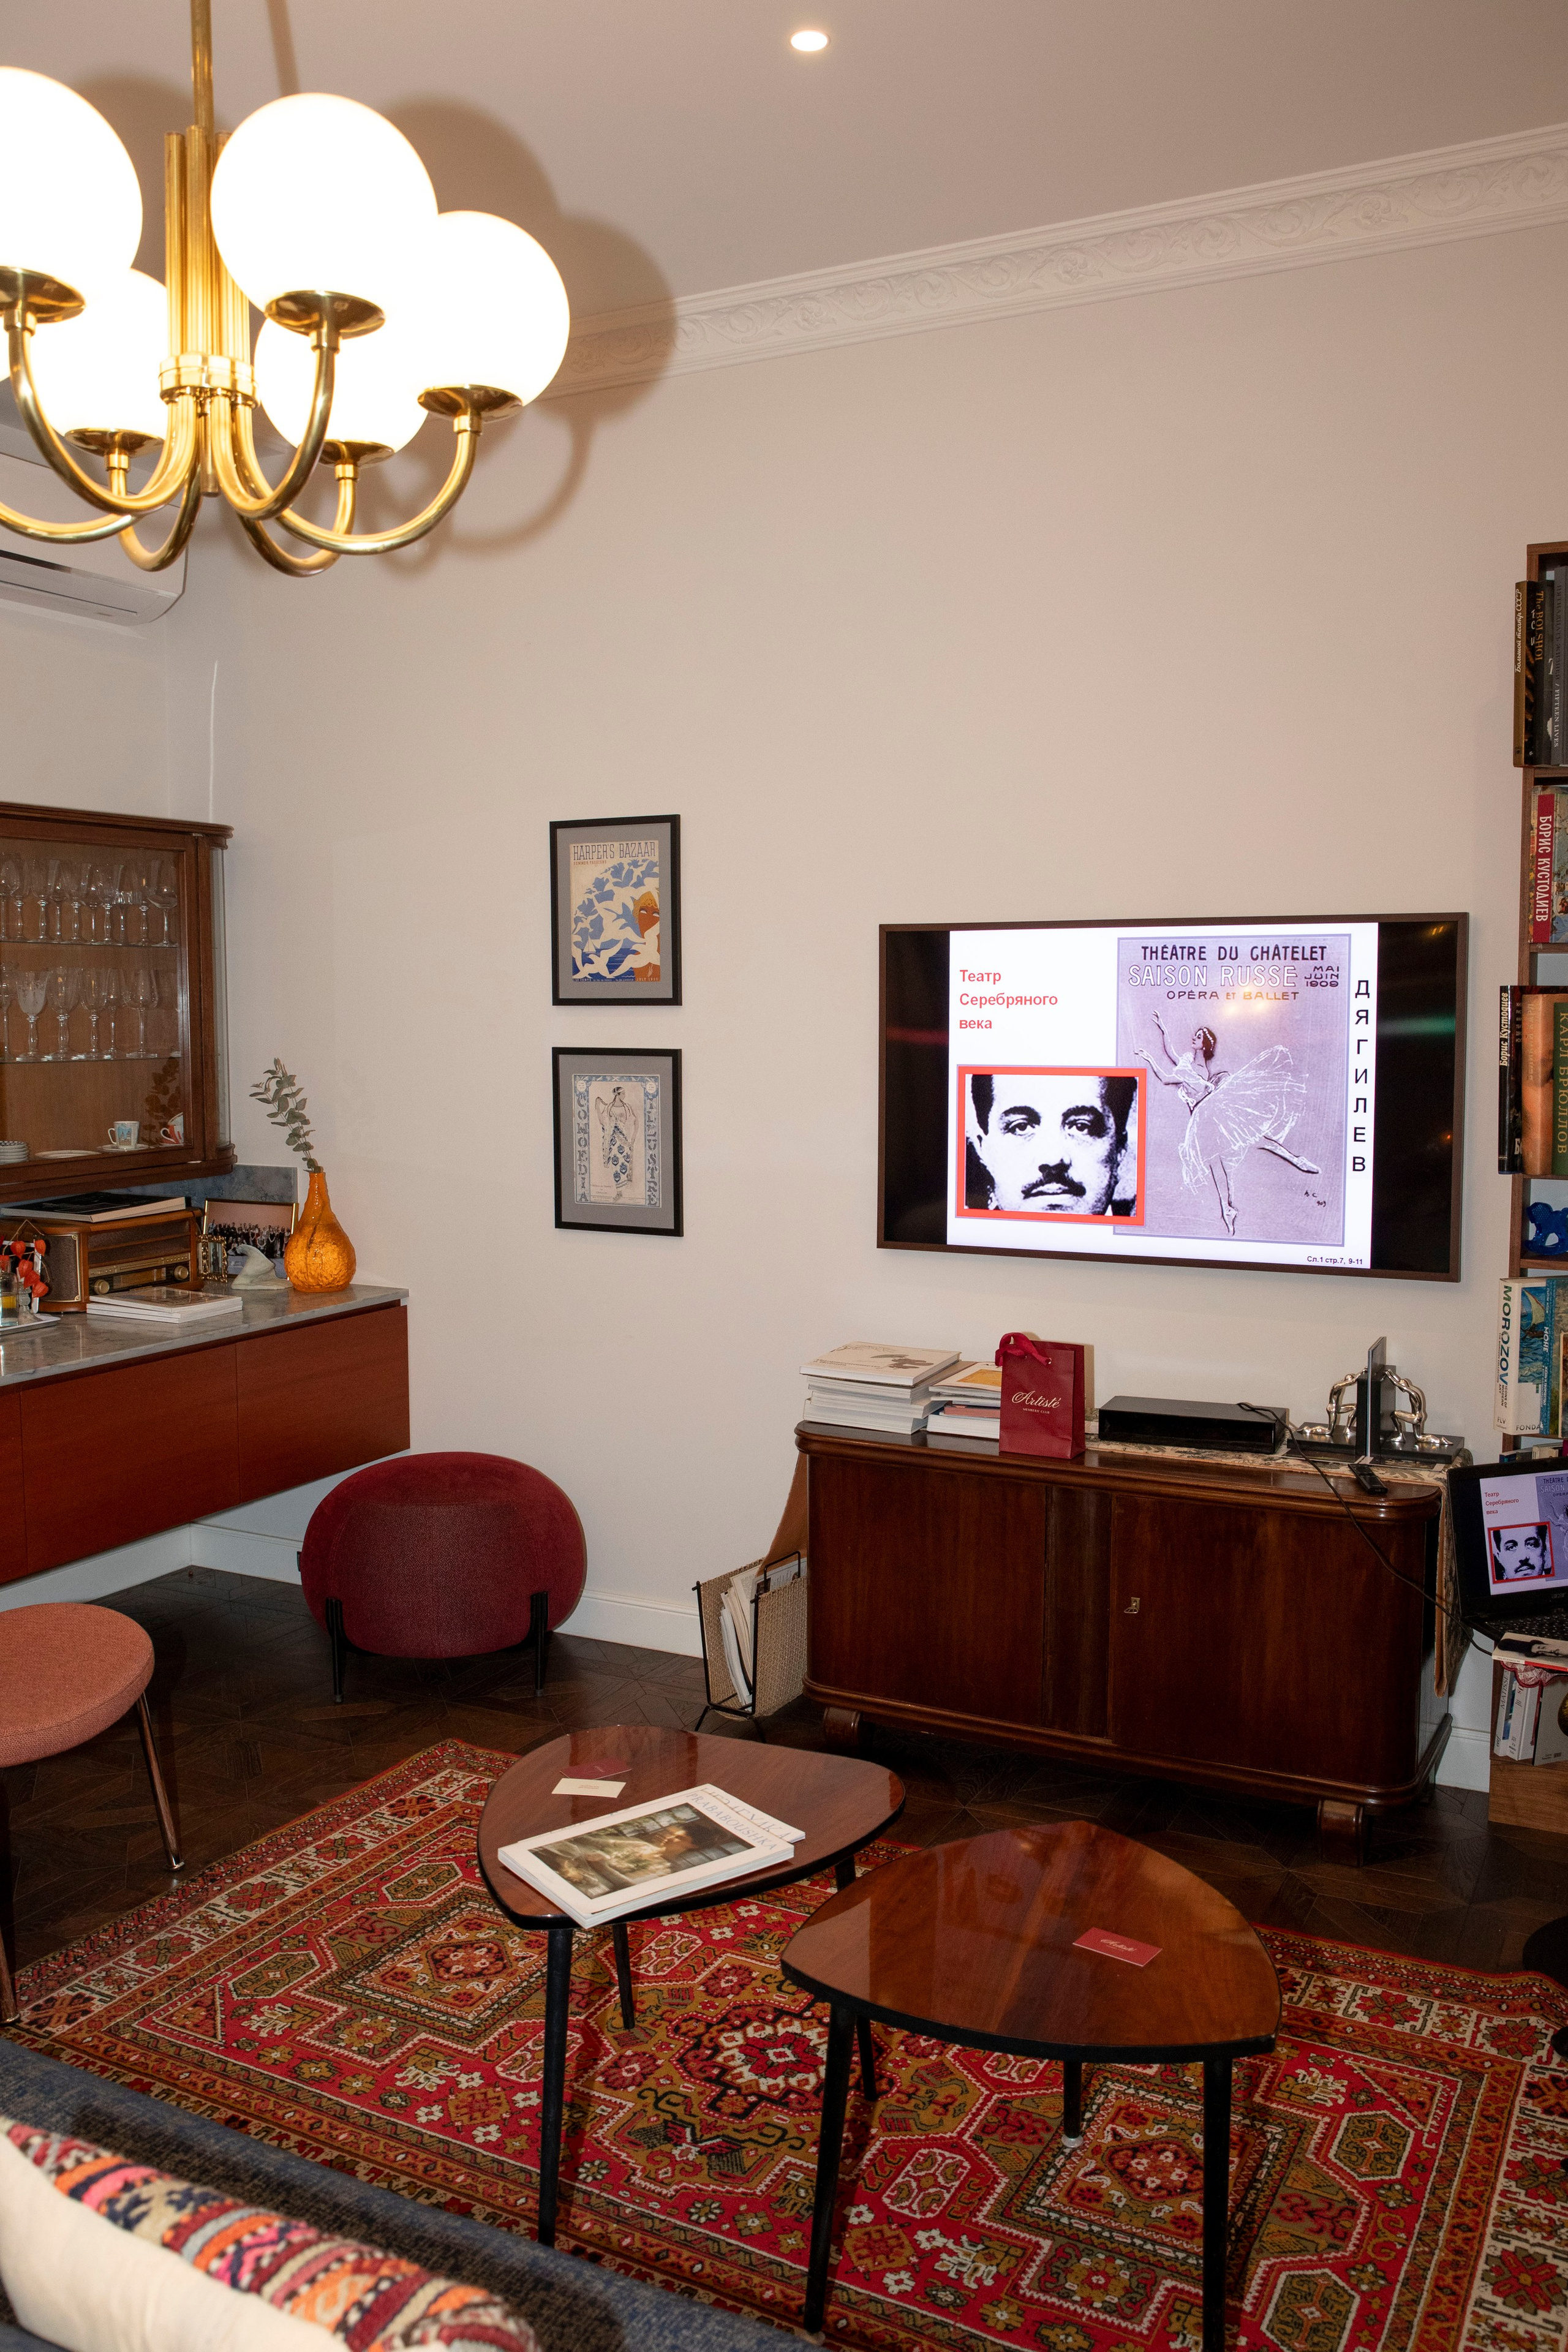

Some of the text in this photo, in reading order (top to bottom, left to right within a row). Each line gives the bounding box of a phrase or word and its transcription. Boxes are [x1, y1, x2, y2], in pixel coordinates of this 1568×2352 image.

[1535, 590, 1544, 660] The BOLSHOI
[573, 841, 656, 861] HARPER'S BAZAAR
[1536, 815, 1551, 922] БОРИС КУСТОДИЕВ
[1141, 944, 1327, 960] THÉÂTRE DU CHÂTELET
[959, 970, 1001, 984] Театр
[1128, 965, 1298, 987] SAISON RUSSE
[959, 992, 1058, 1008] Серебряного
[1167, 990, 1219, 1000] OPÉRA
[1243, 991, 1299, 1000] BALLET
[959, 1020, 992, 1029] века
[1499, 992, 1510, 1066] Борис Кустодиев
[1352, 980, 1370, 1172] ДЯГИЛЕВ
[1557, 1012, 1568, 1154] КАРЛ БРЮЛЛОВ
[1499, 1285, 1512, 1385] MOROZOV
[1012, 1390, 1061, 1408] Artisté
[1540, 1484, 1565, 1493] SAISON
[686, 1793, 778, 1850] PRABABOUSHKA
